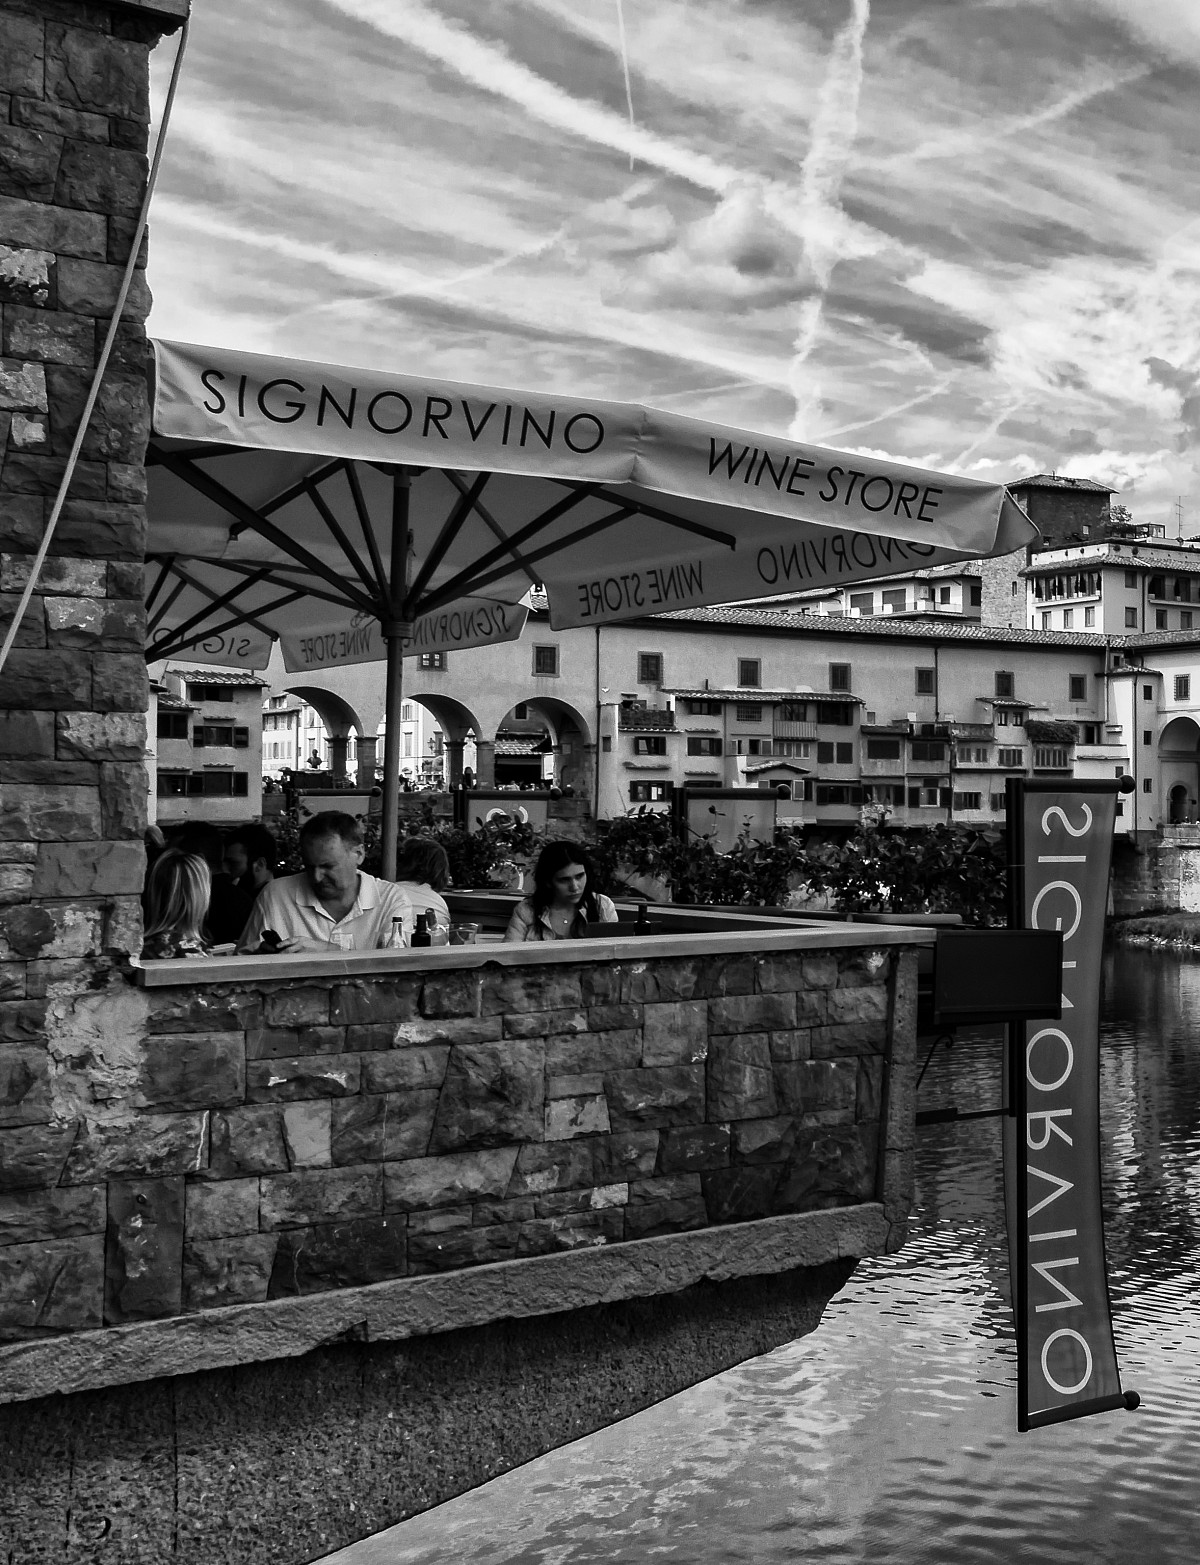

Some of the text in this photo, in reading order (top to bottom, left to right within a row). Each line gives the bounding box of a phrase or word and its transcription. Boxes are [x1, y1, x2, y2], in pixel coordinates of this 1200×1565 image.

[200, 369, 605, 454] SIGNORVINO
[708, 437, 943, 523] WINE STORE
